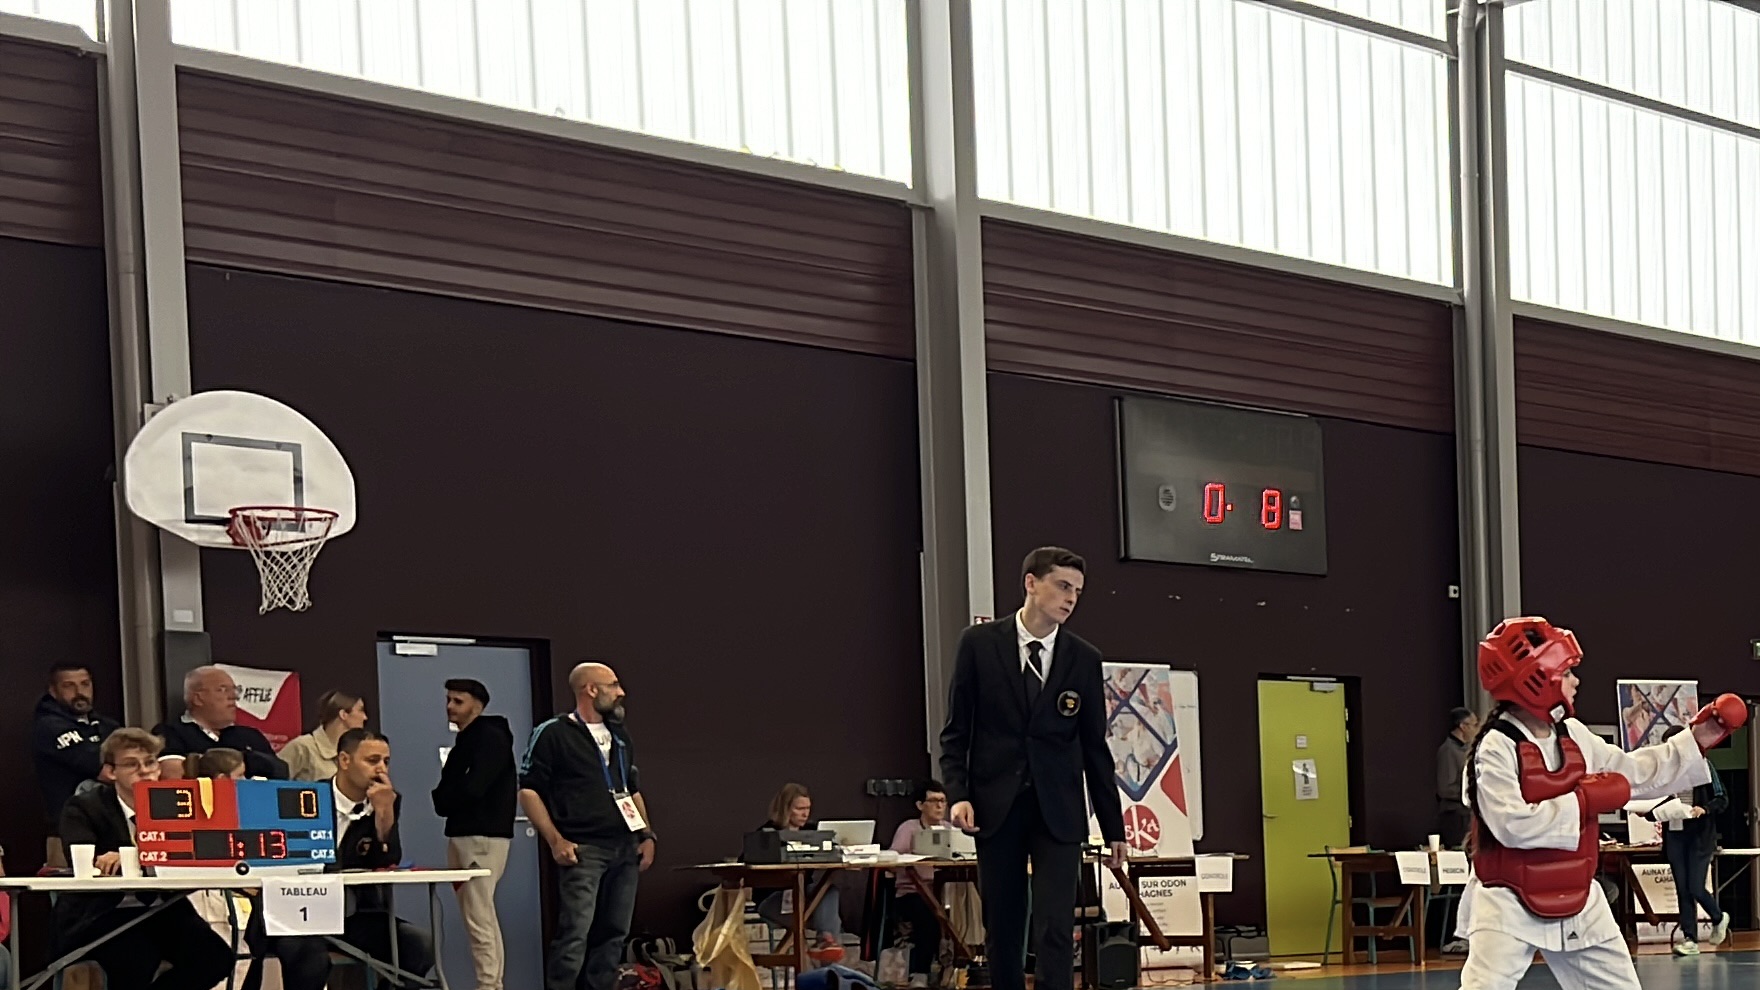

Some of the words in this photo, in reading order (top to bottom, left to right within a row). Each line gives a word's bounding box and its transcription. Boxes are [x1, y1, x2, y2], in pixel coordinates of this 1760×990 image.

[1262, 489, 1282, 529] 8
[176, 789, 193, 818] 3
[299, 790, 318, 818] 0
[139, 831, 166, 841] CAT.1
[310, 830, 333, 840] CAT.1
[228, 831, 287, 860] 1:13
[140, 851, 168, 861] CAT.2
[311, 849, 335, 860] CAT.2
[1141, 880, 1159, 889] SUR
[1160, 879, 1187, 888] ODON
[280, 887, 328, 896] TABLEAU
[299, 906, 308, 922] 1
